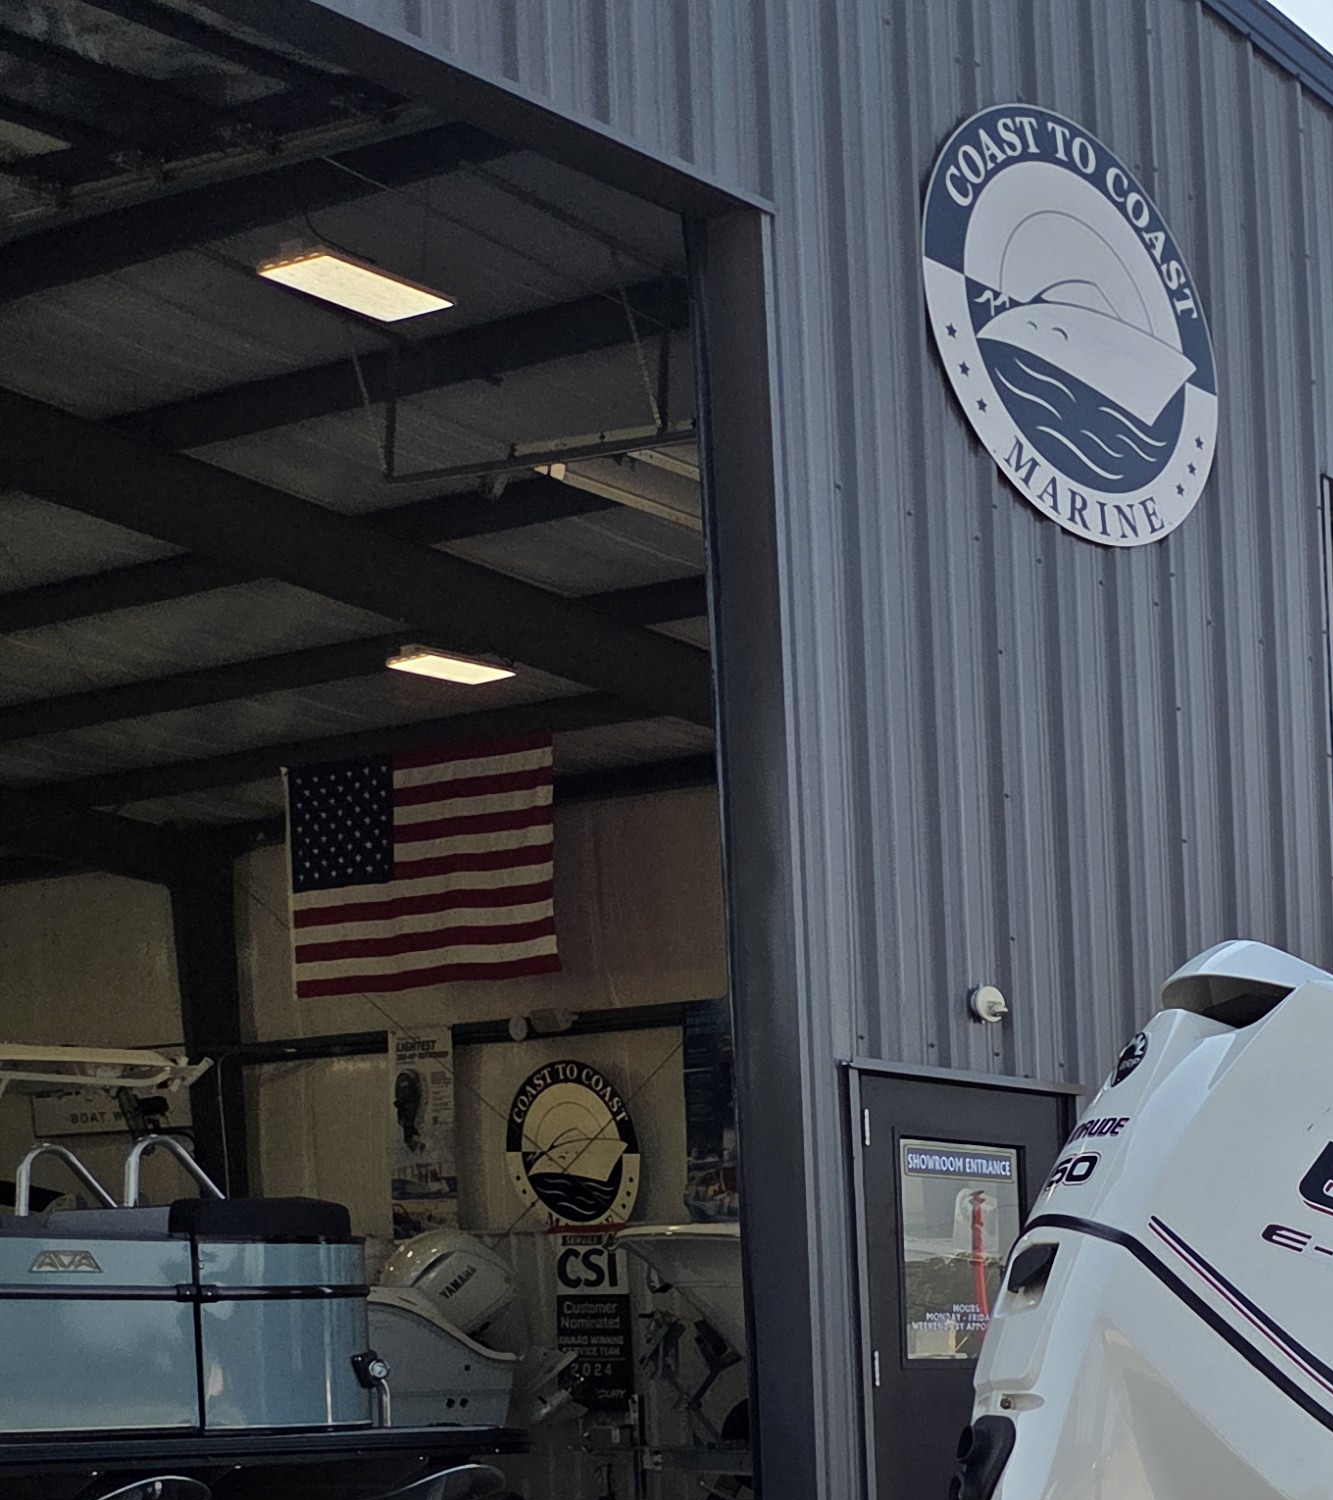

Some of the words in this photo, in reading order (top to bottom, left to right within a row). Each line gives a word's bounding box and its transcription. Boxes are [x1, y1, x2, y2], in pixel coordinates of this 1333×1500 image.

[945, 116, 1039, 207] COAST
[1047, 120, 1096, 174] TO
[1105, 166, 1199, 319] COAST
[1003, 435, 1165, 540] MARINE
[513, 1066, 552, 1124] COAST
[555, 1063, 578, 1080] TO
[581, 1068, 629, 1123] COAST
[907, 1153, 964, 1173] SHOWROOM
[965, 1156, 1011, 1176] ENTRANCE
[439, 1265, 478, 1299] YAMAHA
[557, 1248, 618, 1289] CSI
[560, 1315, 621, 1329] Nominated
[563, 1301, 618, 1314] Customer
[571, 1363, 613, 1377] 2024
